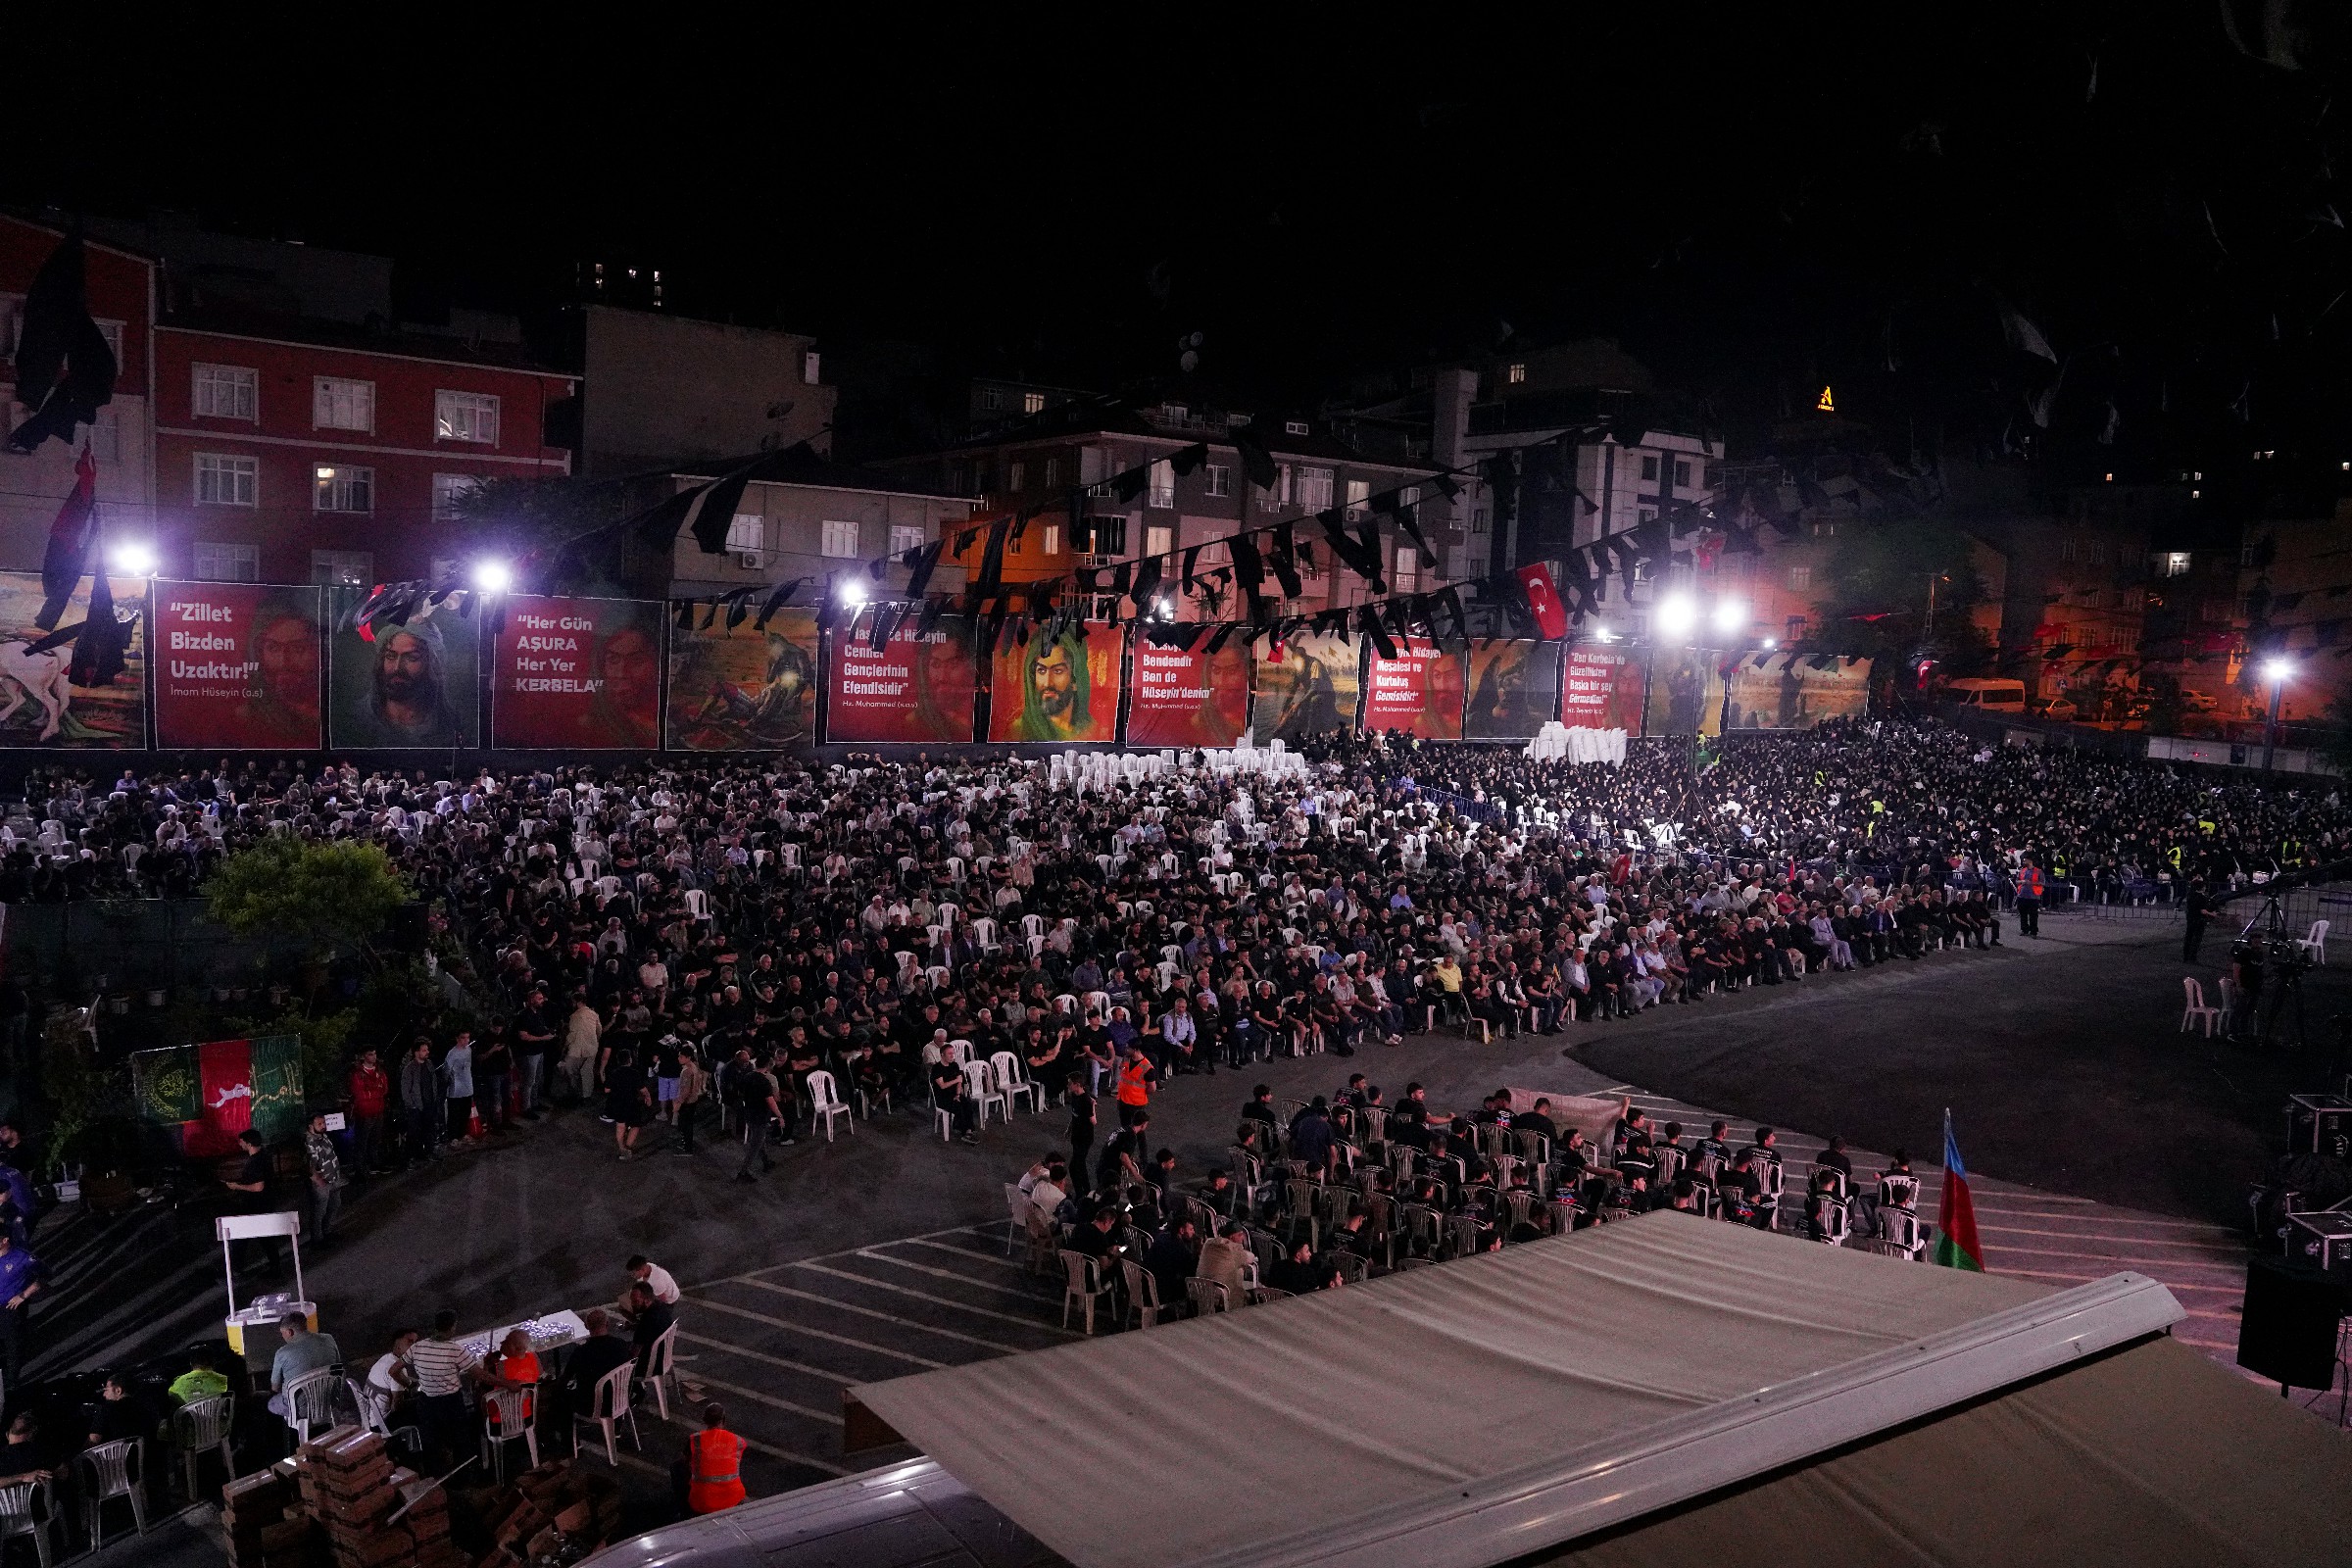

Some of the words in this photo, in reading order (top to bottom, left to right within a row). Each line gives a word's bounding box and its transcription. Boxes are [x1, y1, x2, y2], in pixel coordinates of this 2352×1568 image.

[170, 602, 232, 622] “Zillet
[516, 614, 556, 629] “Her
[560, 616, 593, 631] Gün
[171, 630, 235, 651] Bizden
[516, 635, 578, 653] AŞURA
[516, 657, 547, 670] Her
[549, 658, 576, 672] Yer
[1143, 654, 1194, 666] Bendendir
[1412, 662, 1422, 673] ve
[171, 660, 260, 680] Uzaktır!”
[844, 662, 908, 678] Gençlerinin
[1142, 670, 1162, 683] Ben
[1164, 670, 1177, 683] de
[515, 677, 605, 693] KERBELA”
[843, 680, 909, 696] Efendisidir”
[1376, 674, 1409, 689] Kurtuluş
[1569, 679, 1589, 692] Başka
[1590, 680, 1600, 691] bir
[170, 683, 198, 697] İmam
[201, 687, 239, 699] Hüseyin
